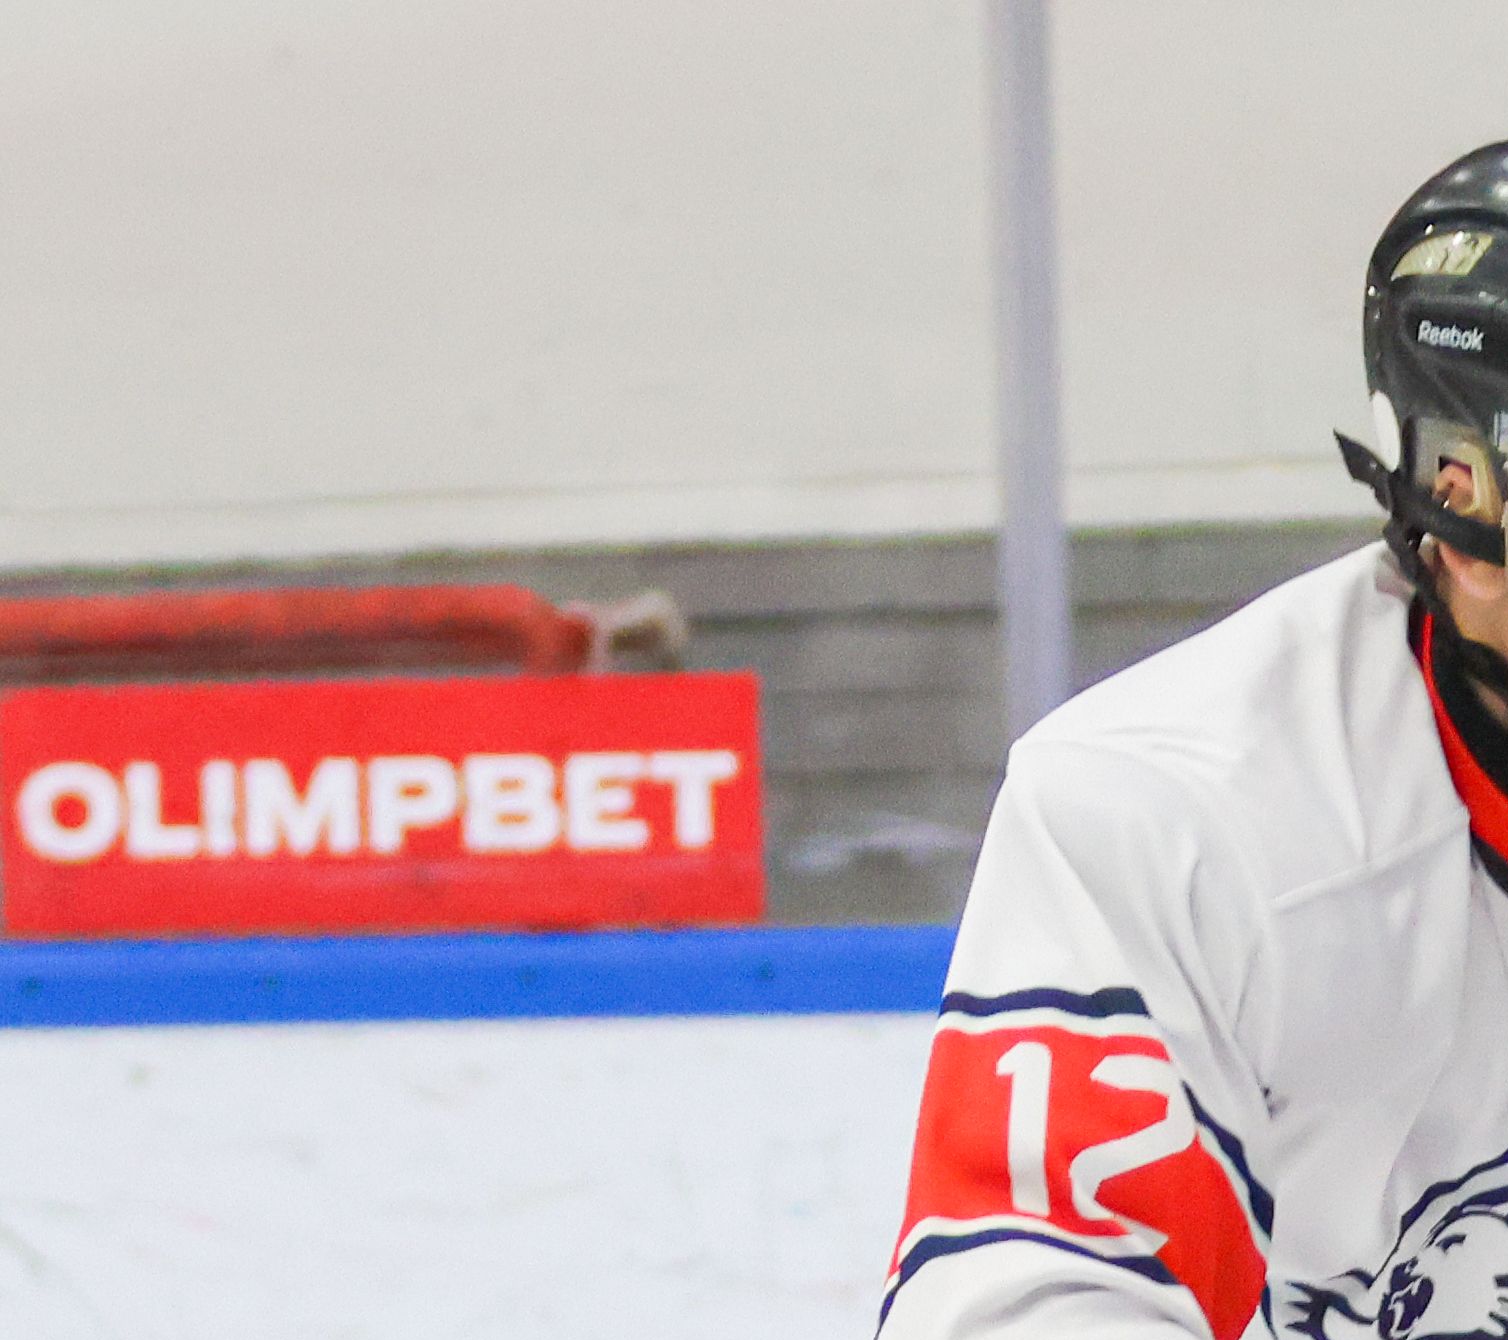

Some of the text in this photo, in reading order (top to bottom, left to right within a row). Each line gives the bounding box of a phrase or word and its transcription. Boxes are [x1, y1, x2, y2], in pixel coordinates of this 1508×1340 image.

[1418, 320, 1484, 353] Reebok
[18, 749, 738, 863] OLIMPBET
[996, 1040, 1200, 1257] 12
